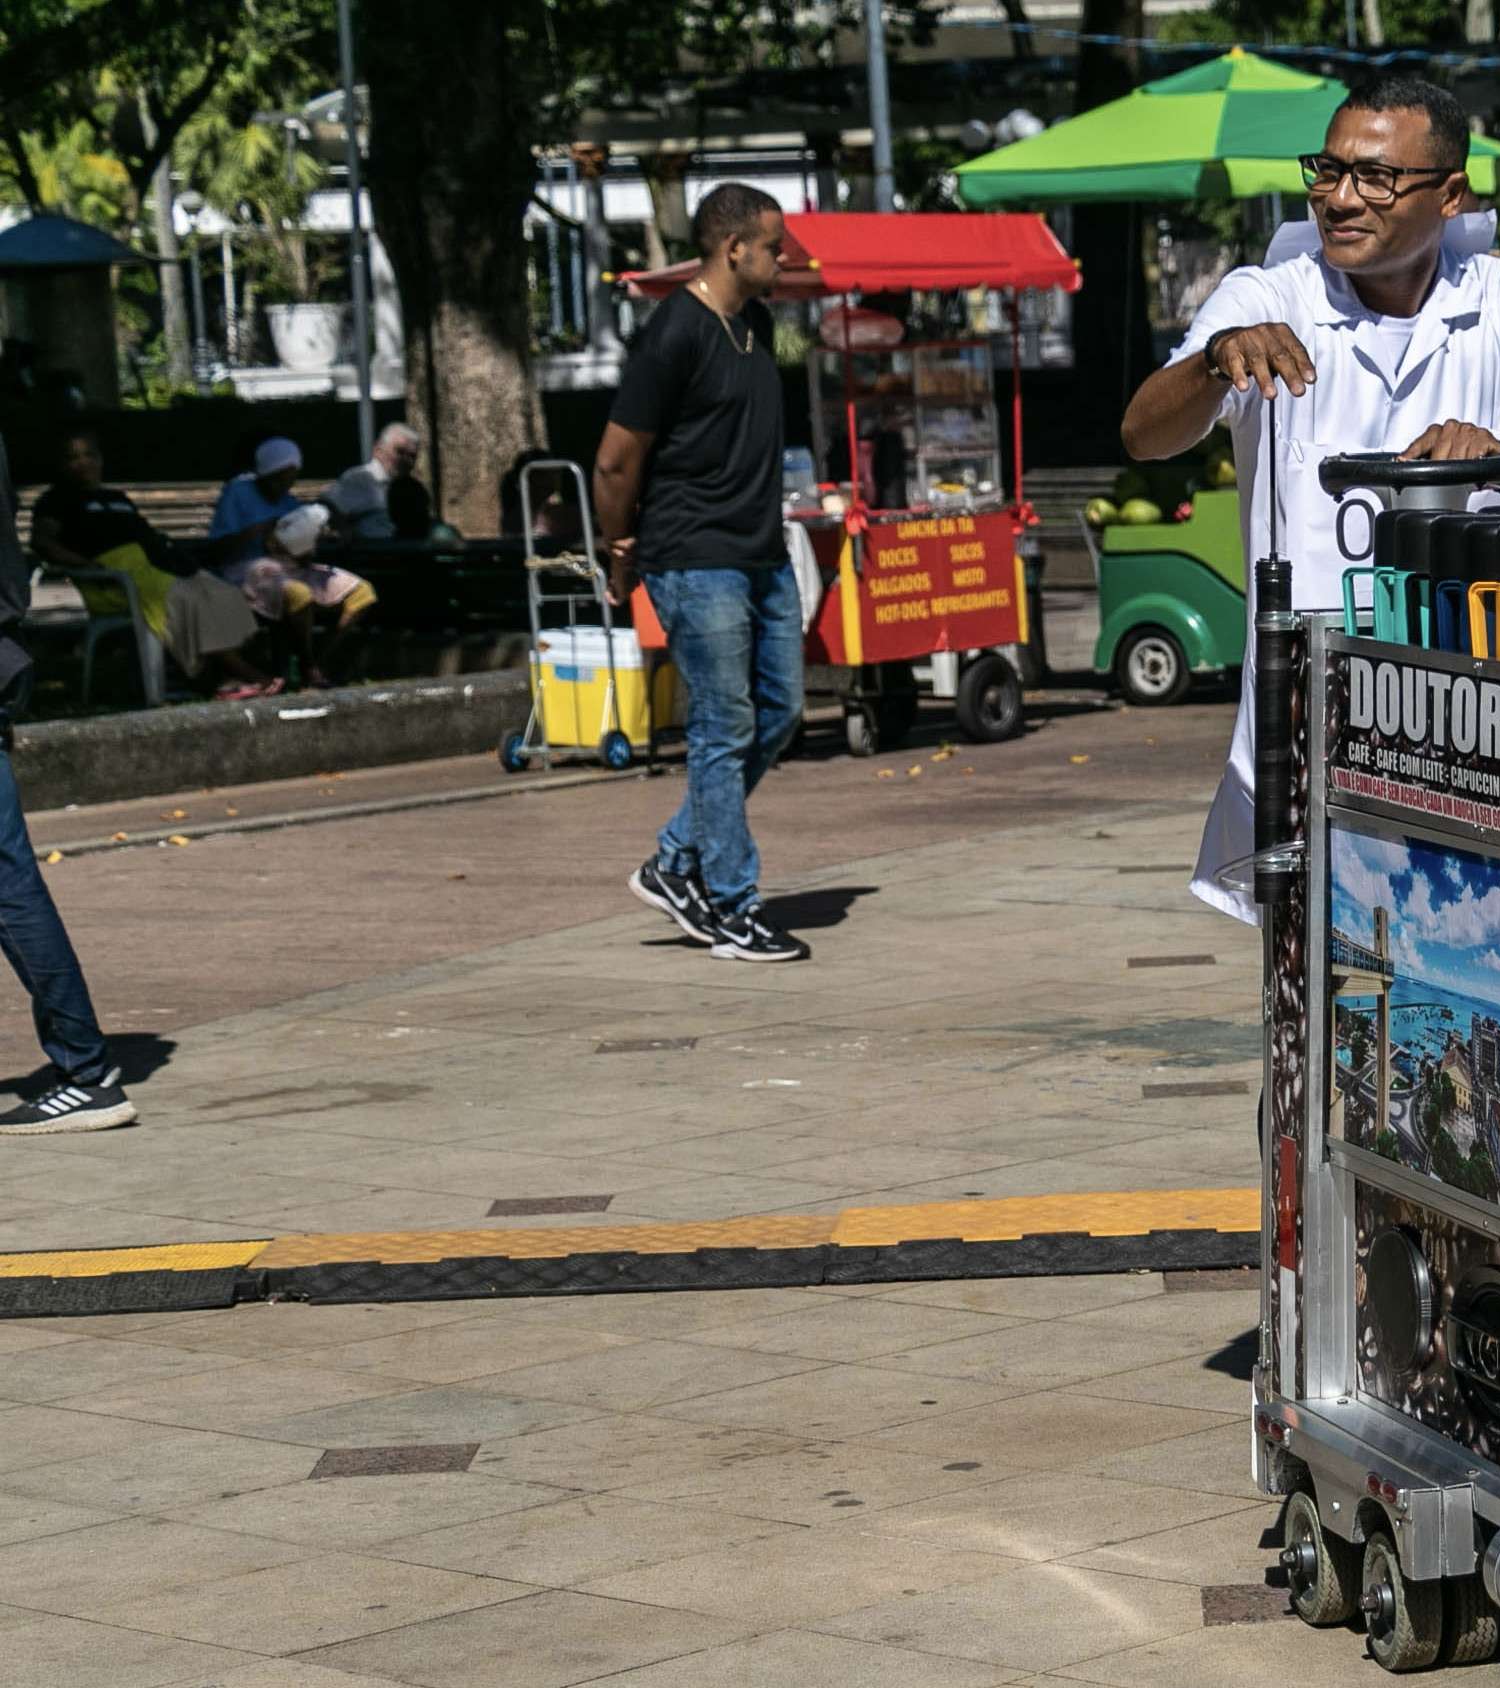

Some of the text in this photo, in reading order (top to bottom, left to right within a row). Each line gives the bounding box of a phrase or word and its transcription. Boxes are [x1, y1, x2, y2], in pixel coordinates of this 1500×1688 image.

[878, 546, 918, 569] DOCES
[950, 541, 985, 563] SUCOS
[869, 572, 932, 598] SALGADOS
[952, 567, 986, 587] MISTO
[930, 589, 1010, 615] REFRIGERANTES
[1348, 741, 1370, 765] CAFÉ
[1376, 748, 1398, 771] CAFÉ
[1399, 752, 1421, 777] COM
[1422, 759, 1444, 783] LEITE
